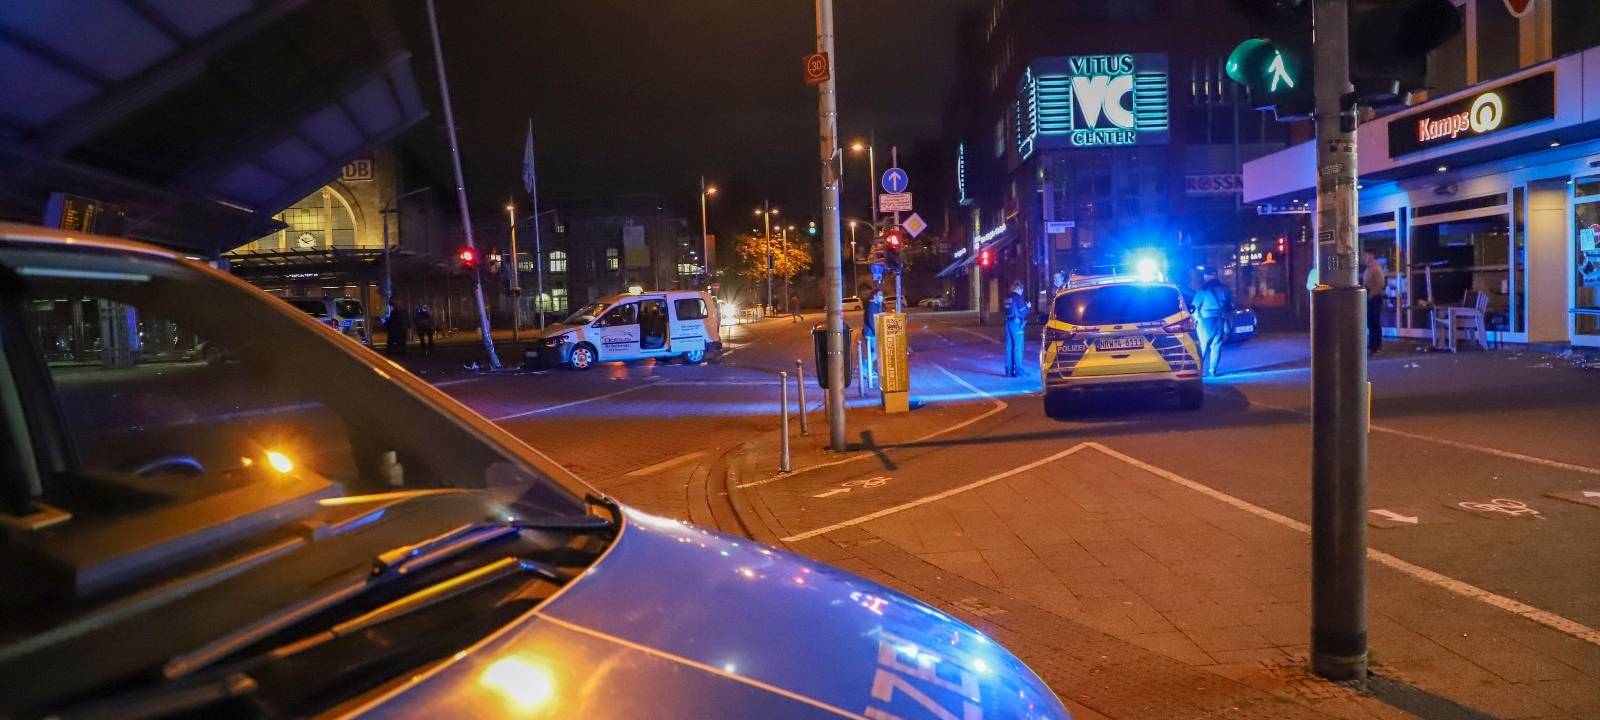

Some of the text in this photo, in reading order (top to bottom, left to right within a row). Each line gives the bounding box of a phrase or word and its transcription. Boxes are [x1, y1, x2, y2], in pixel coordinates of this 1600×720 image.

[811, 60, 822, 71] 30
[1070, 55, 1133, 74] VITUS
[1418, 112, 1470, 142] Kamps
[1073, 131, 1135, 145] CENTER
[346, 161, 369, 178] DB
